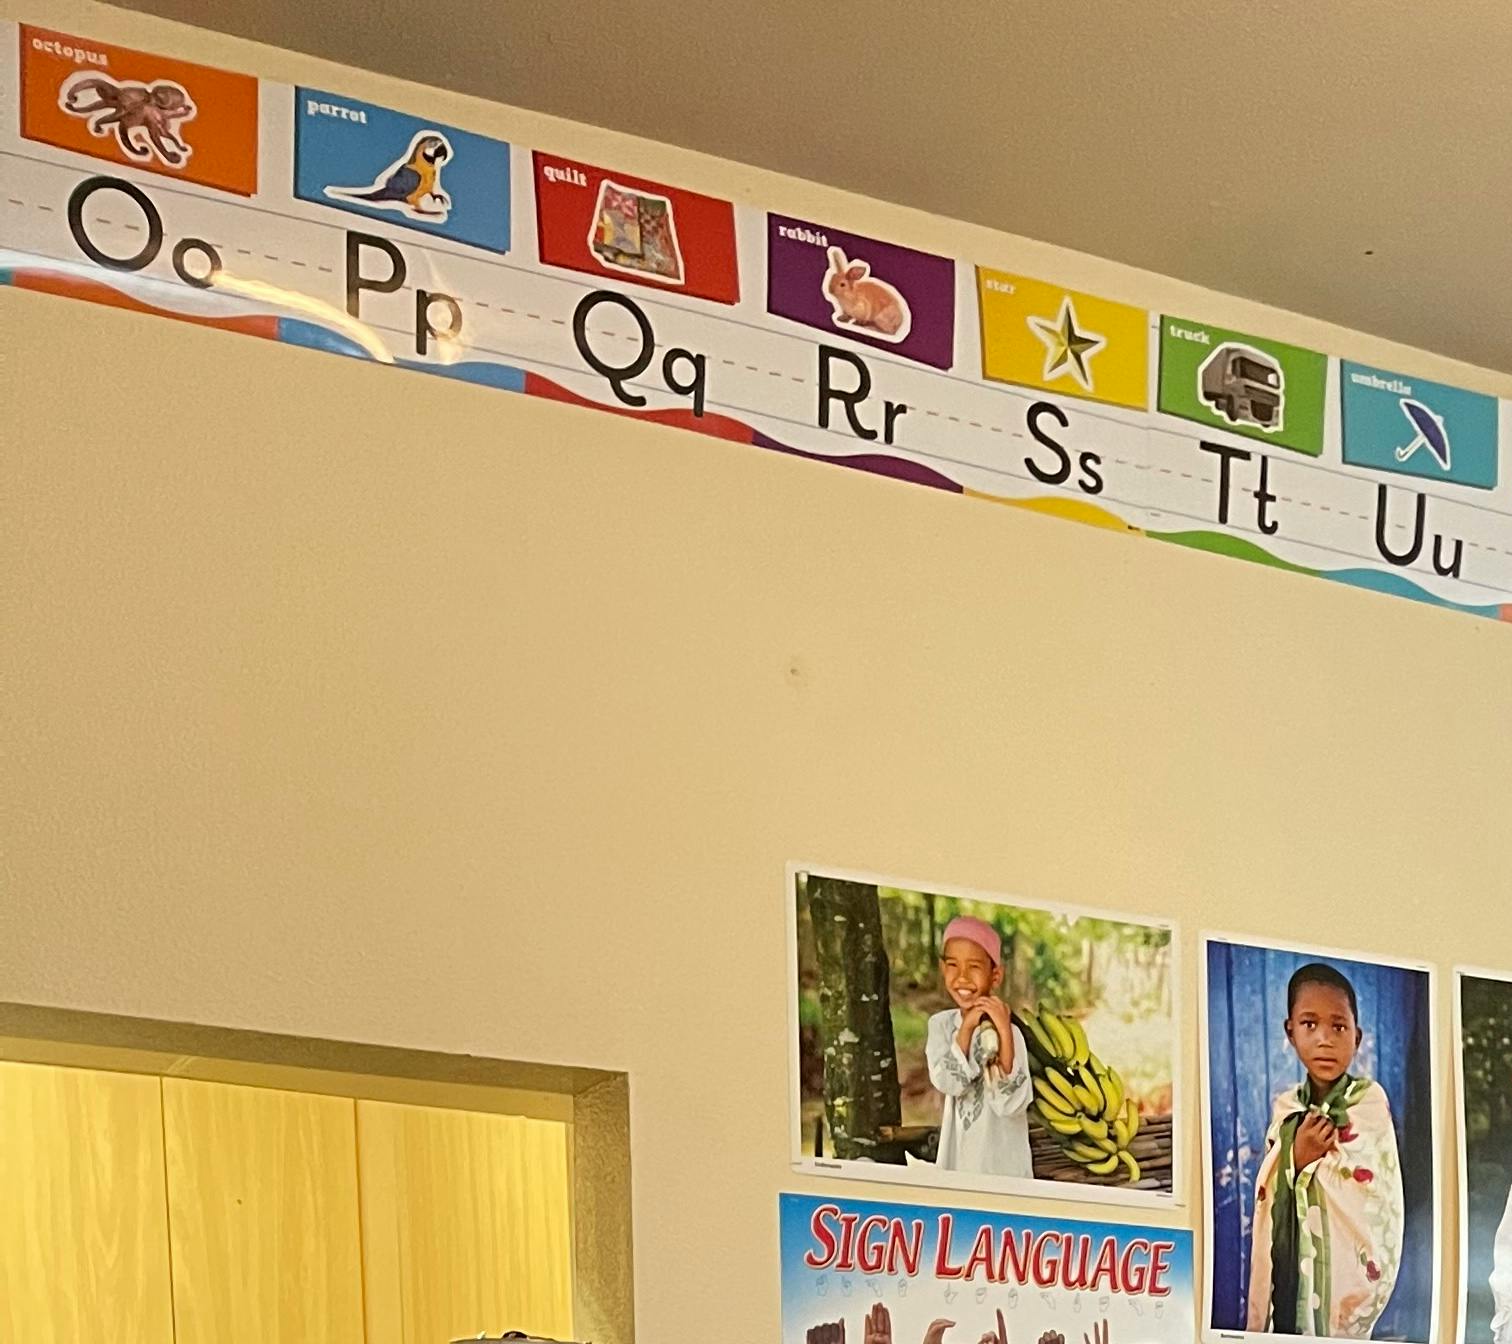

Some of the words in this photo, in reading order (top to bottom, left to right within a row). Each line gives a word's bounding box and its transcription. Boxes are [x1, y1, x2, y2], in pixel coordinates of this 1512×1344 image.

[33, 37, 108, 66] octopus
[308, 100, 366, 123] parrot
[543, 164, 587, 187] quilt
[68, 176, 223, 289] Oo
[778, 224, 828, 248] rabbit
[346, 232, 463, 356] Pp
[986, 280, 1016, 295] star
[574, 290, 707, 416] Qq
[1169, 325, 1210, 345] truck
[818, 345, 906, 446] Rr
[1351, 373, 1412, 396] umbrella
[1024, 401, 1104, 494] Ss
[1200, 441, 1279, 535] Tt
[1376, 484, 1463, 578] Uu
[805, 1204, 924, 1277] SIGN
[935, 1215, 1175, 1296] LANGUAGE
